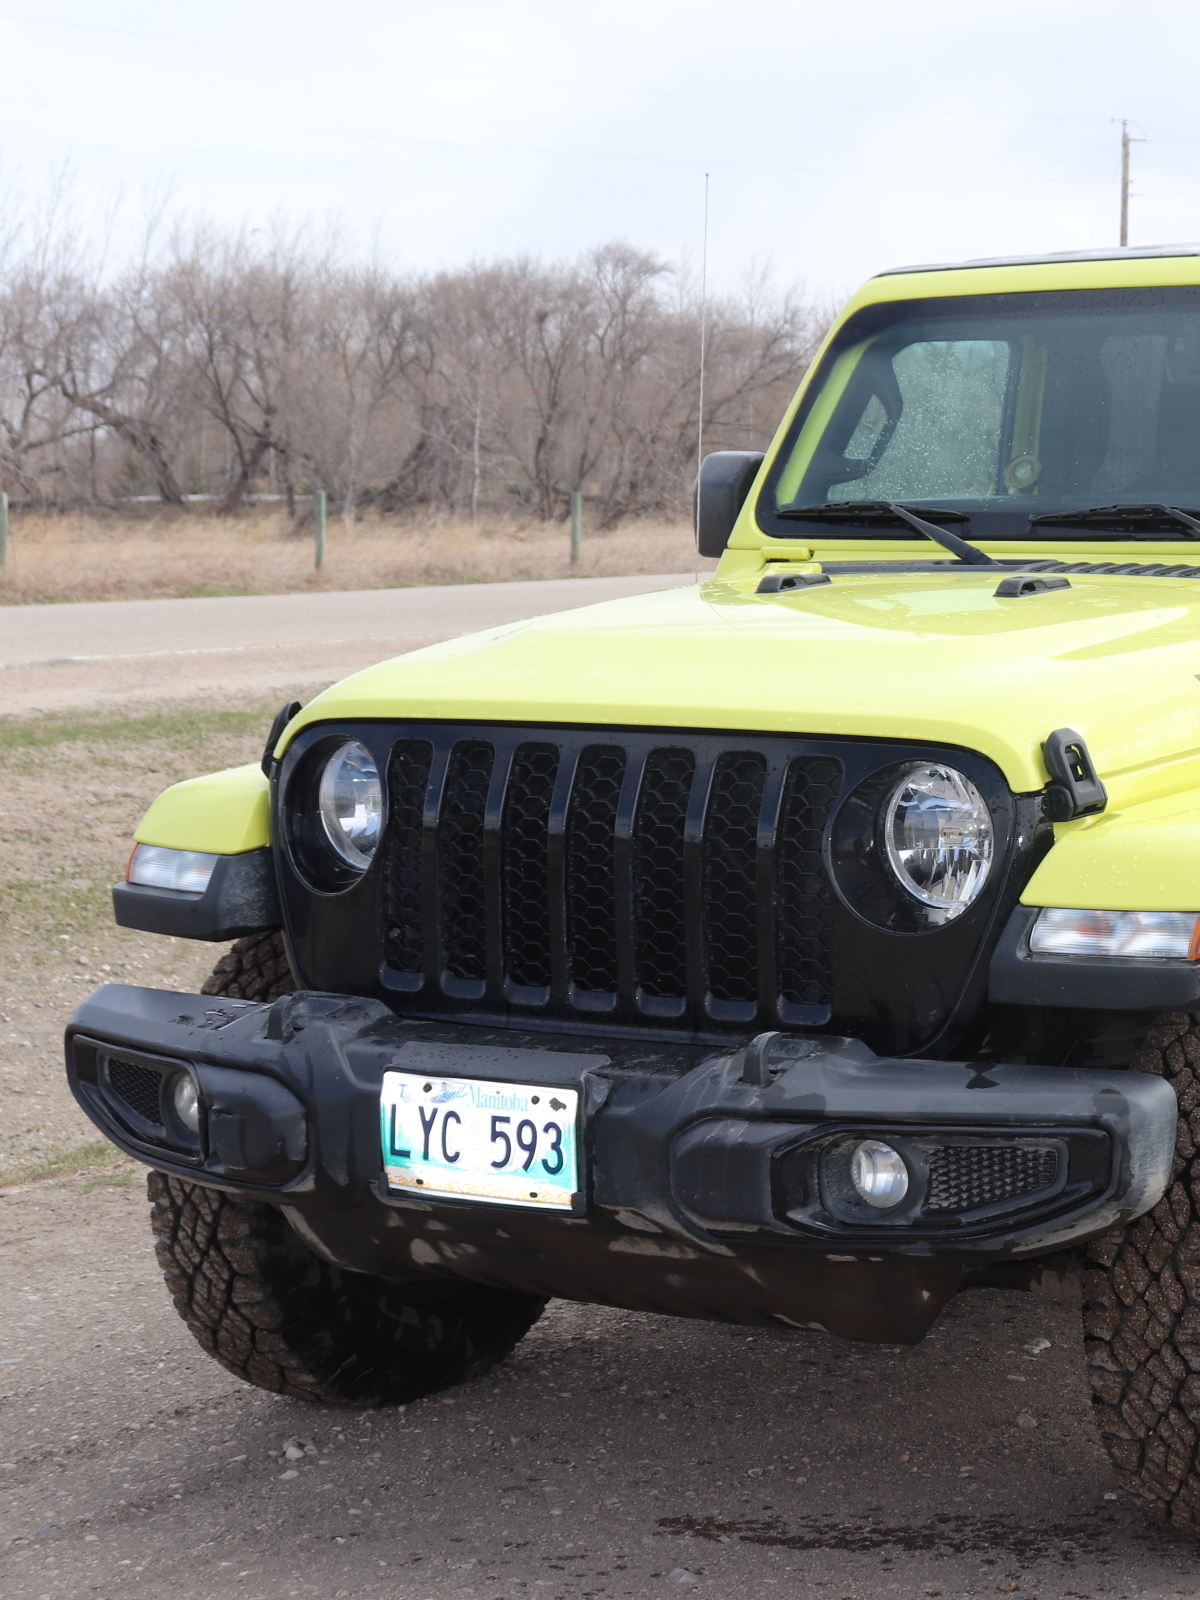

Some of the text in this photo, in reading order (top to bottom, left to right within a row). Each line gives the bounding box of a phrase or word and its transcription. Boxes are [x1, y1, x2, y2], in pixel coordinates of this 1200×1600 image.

[467, 1085, 528, 1112] Manitoba
[390, 1104, 564, 1175] LYC 593
